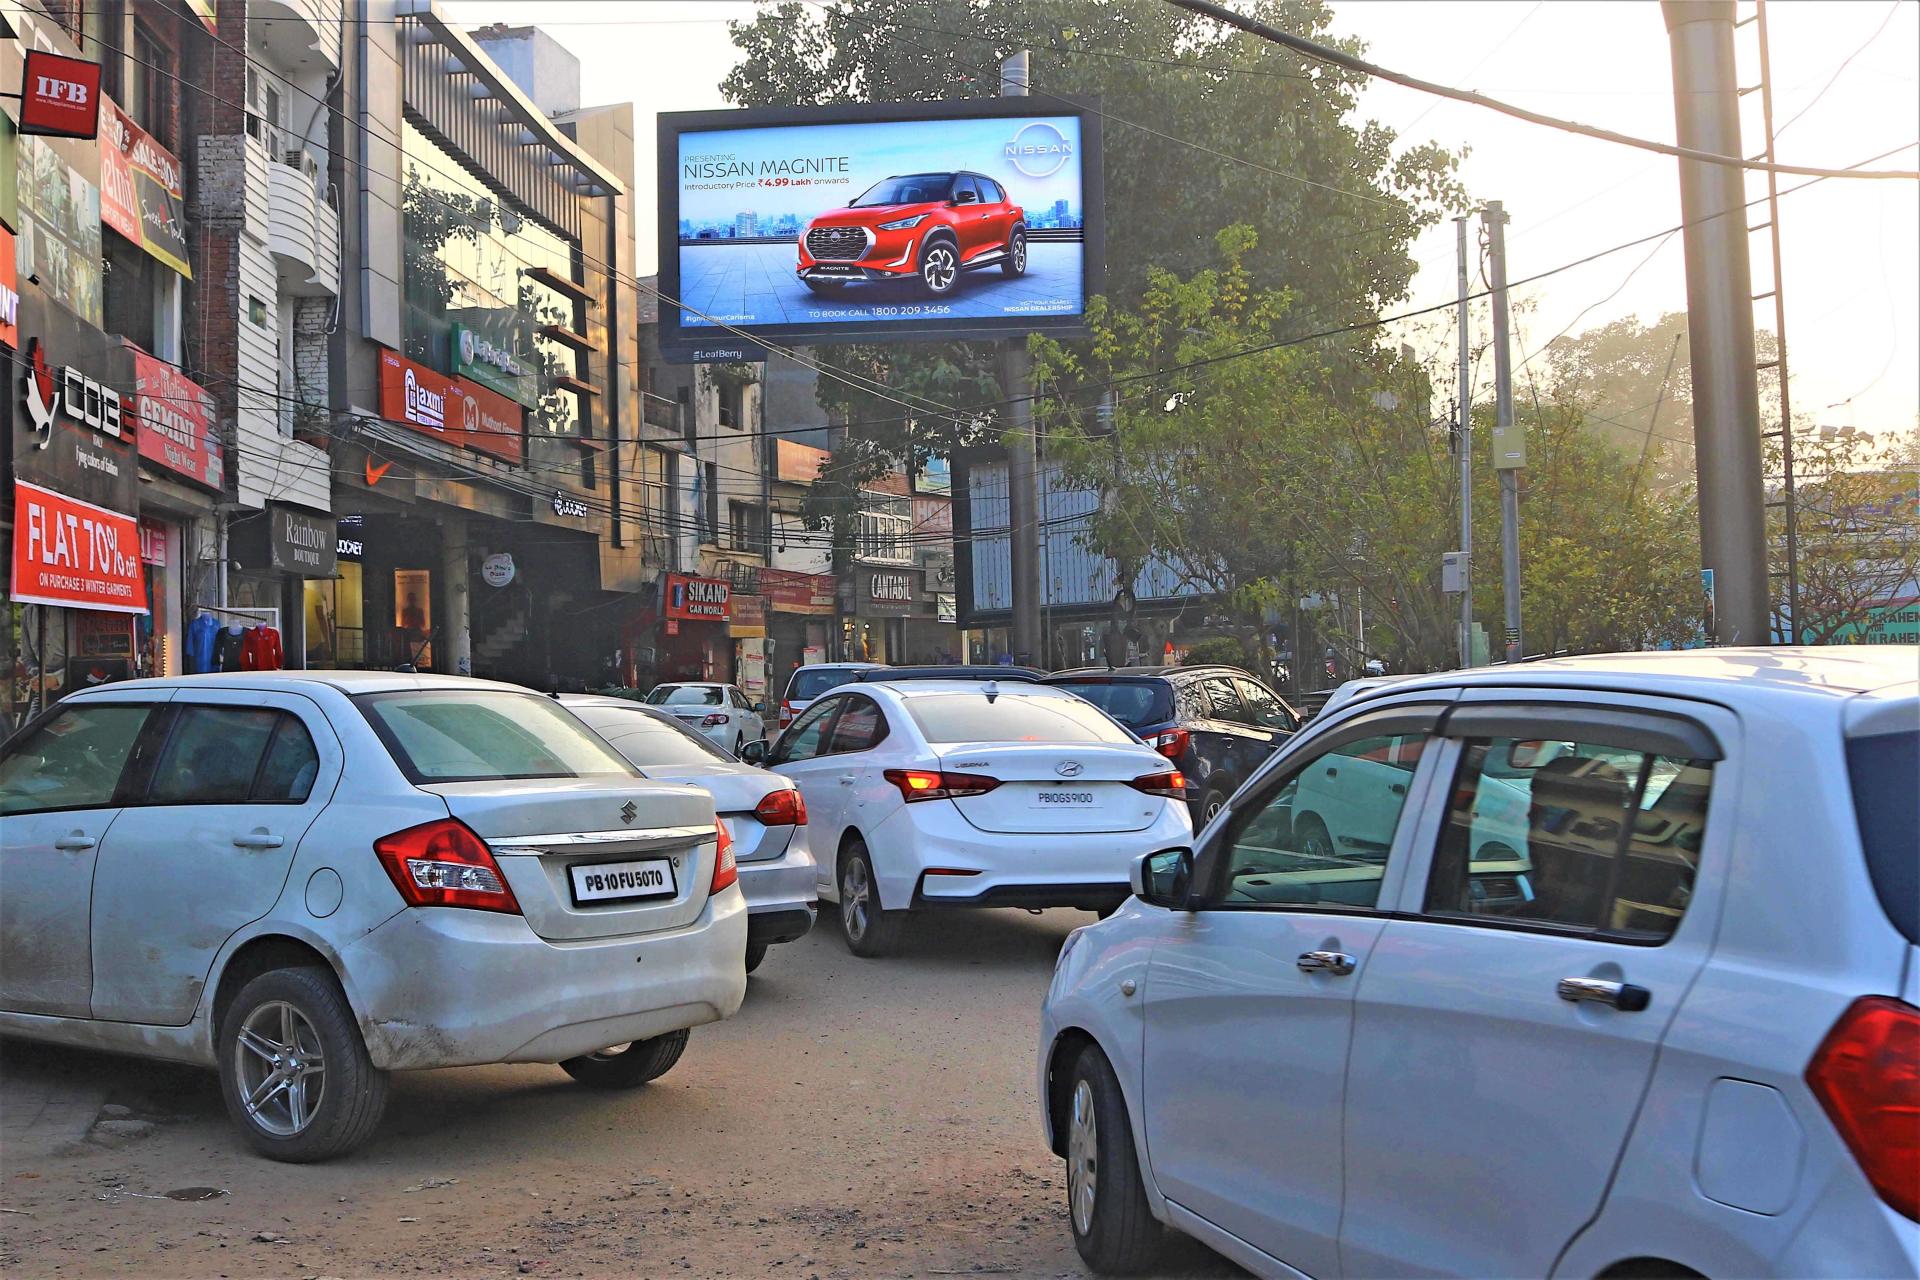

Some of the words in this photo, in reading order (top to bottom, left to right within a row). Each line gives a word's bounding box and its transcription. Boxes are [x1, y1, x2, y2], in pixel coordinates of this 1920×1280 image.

[36, 75, 87, 103] IFB
[684, 153, 736, 163] PRESENTING
[1006, 144, 1073, 155] NISSAN
[684, 161, 754, 179] NISSAN
[760, 157, 849, 176] MAGNITE
[684, 182, 735, 190] Introductory
[814, 177, 850, 185] onwards
[822, 310, 847, 318] BOOK
[848, 309, 870, 317] CALL
[872, 307, 898, 316] 1800
[901, 306, 921, 315] 209
[923, 305, 951, 315] 3456
[1030, 304, 1074, 312] DEALERSHIP
[141, 396, 196, 451] GEMINI
[164, 442, 181, 466] Night
[182, 451, 197, 473] Wear
[28, 503, 79, 569] FLAT
[83, 519, 125, 577] 70%
[126, 556, 137, 578] off
[286, 513, 327, 550] Rainbow
[294, 548, 320, 567] BOUTIQUE
[39, 572, 50, 587] ON
[50, 573, 80, 592] PURCHASE
[80, 578, 85, 592] 3
[85, 578, 106, 595] WINTER
[106, 582, 132, 598] GARMENTS
[688, 581, 729, 603] SIKAND
[871, 574, 913, 601] CANTABIL
[689, 604, 703, 615] CAR
[703, 605, 725, 616] WORLD
